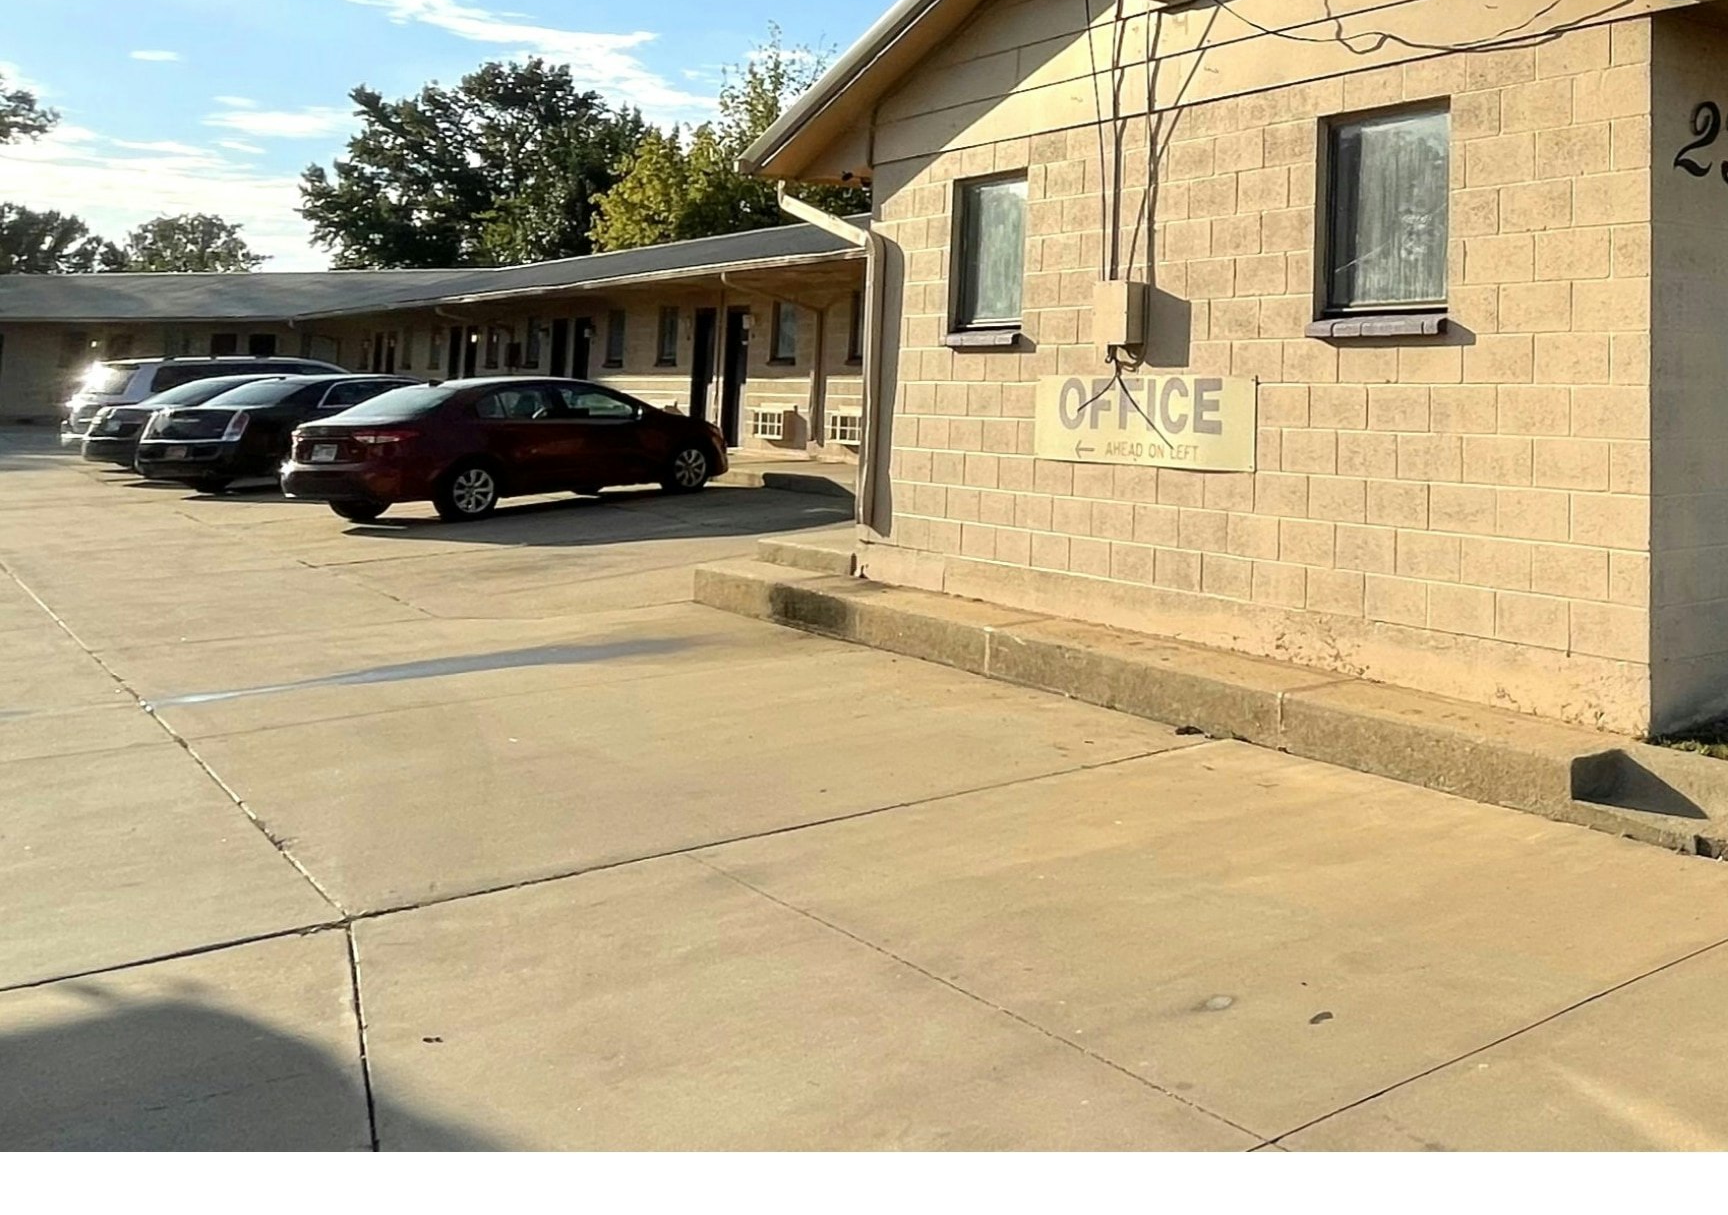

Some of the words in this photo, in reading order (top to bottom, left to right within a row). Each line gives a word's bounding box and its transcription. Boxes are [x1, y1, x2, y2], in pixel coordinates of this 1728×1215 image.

[1058, 377, 1223, 435] OFFICE
[1105, 441, 1143, 458] AHEAD
[1149, 443, 1164, 458] ON
[1170, 445, 1199, 459] LEFT
